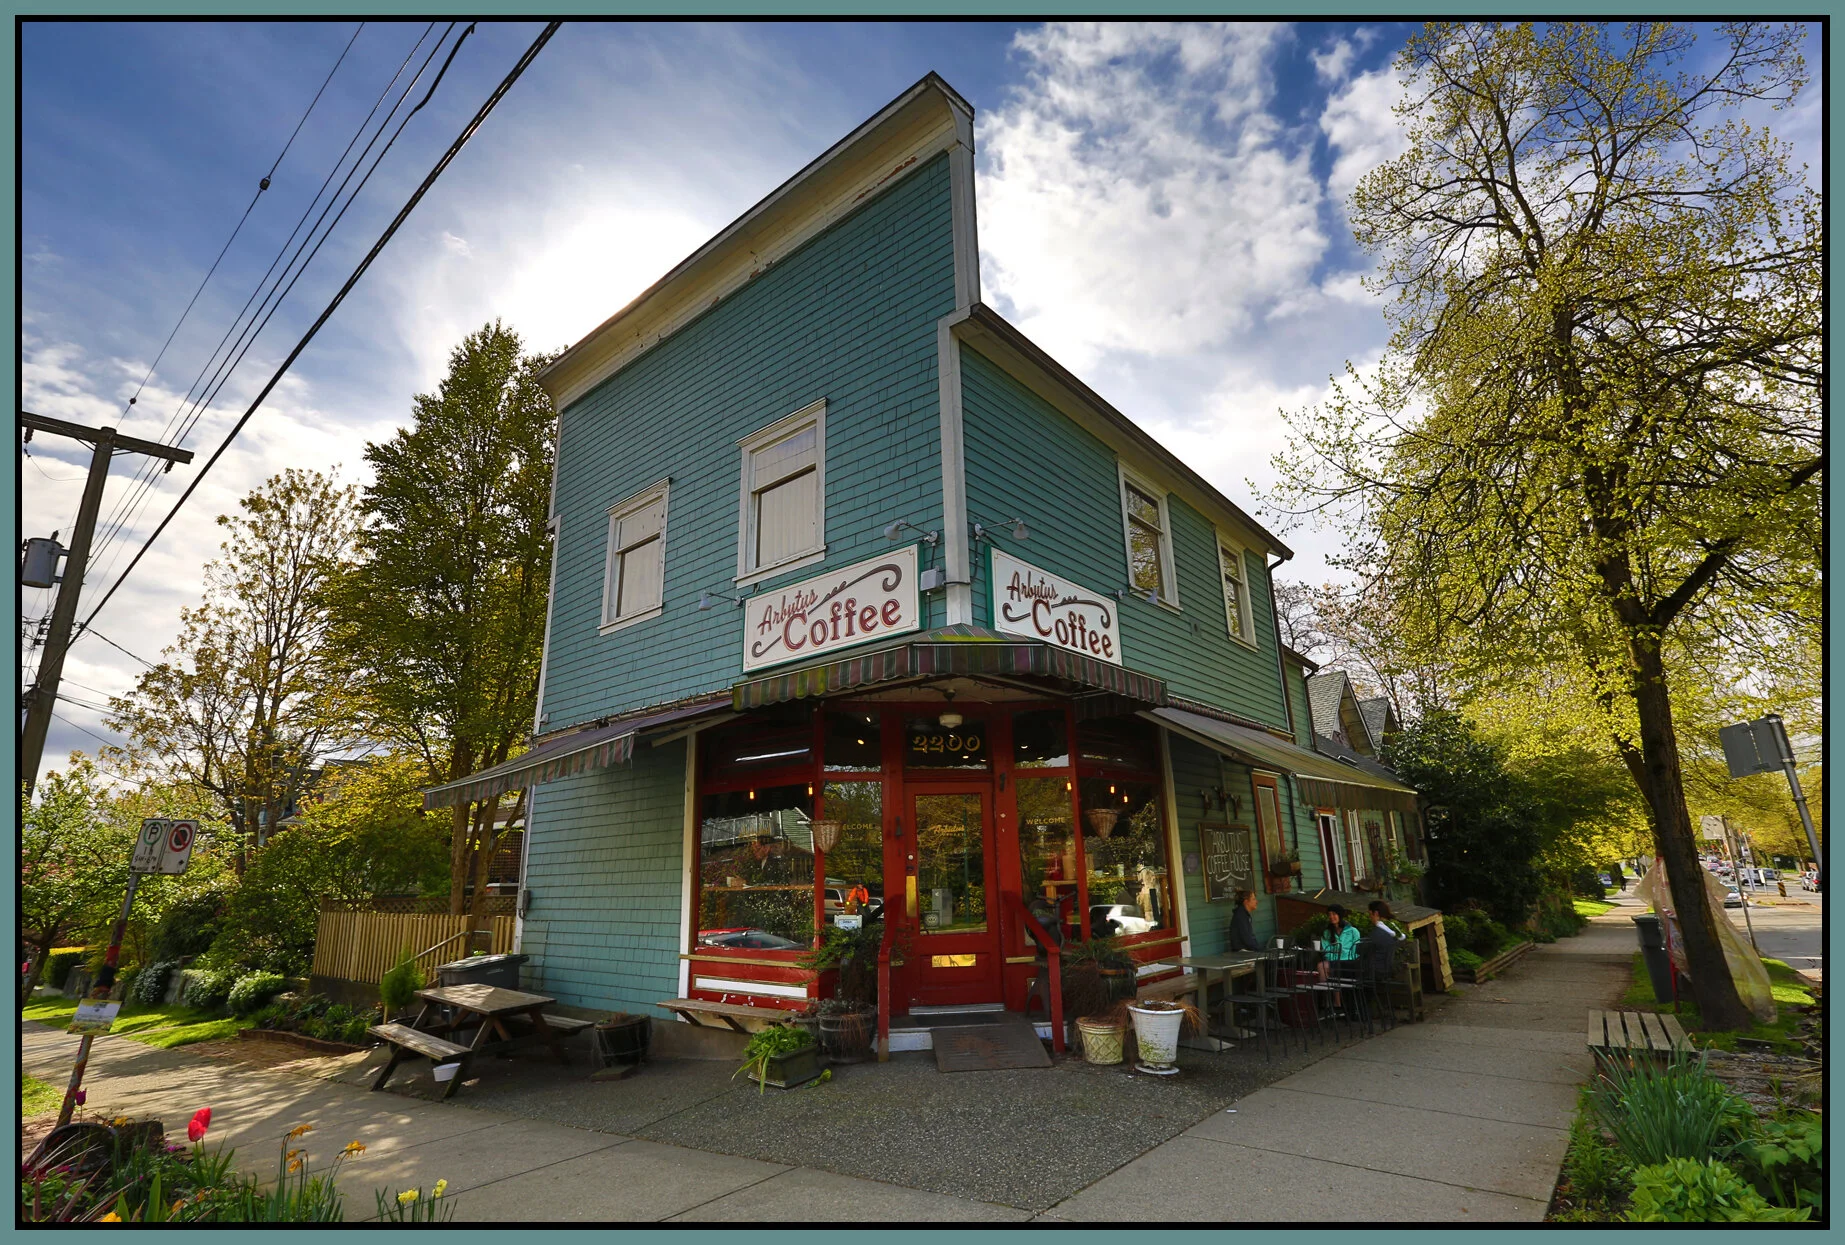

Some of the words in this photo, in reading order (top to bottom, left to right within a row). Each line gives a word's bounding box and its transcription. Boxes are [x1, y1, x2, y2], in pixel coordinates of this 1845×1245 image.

[1006, 570, 1059, 602] Arbutus
[757, 589, 819, 636] Arbutus
[783, 598, 902, 652] Coffee
[1032, 599, 1114, 658] Coffee
[912, 734, 981, 753] 2200
[842, 823, 874, 831] ELCOME
[1025, 816, 1067, 825] WELCOME
[148, 826, 160, 840] P
[1206, 854, 1230, 874] COFFEE
[1229, 853, 1251, 871] HOUSE
